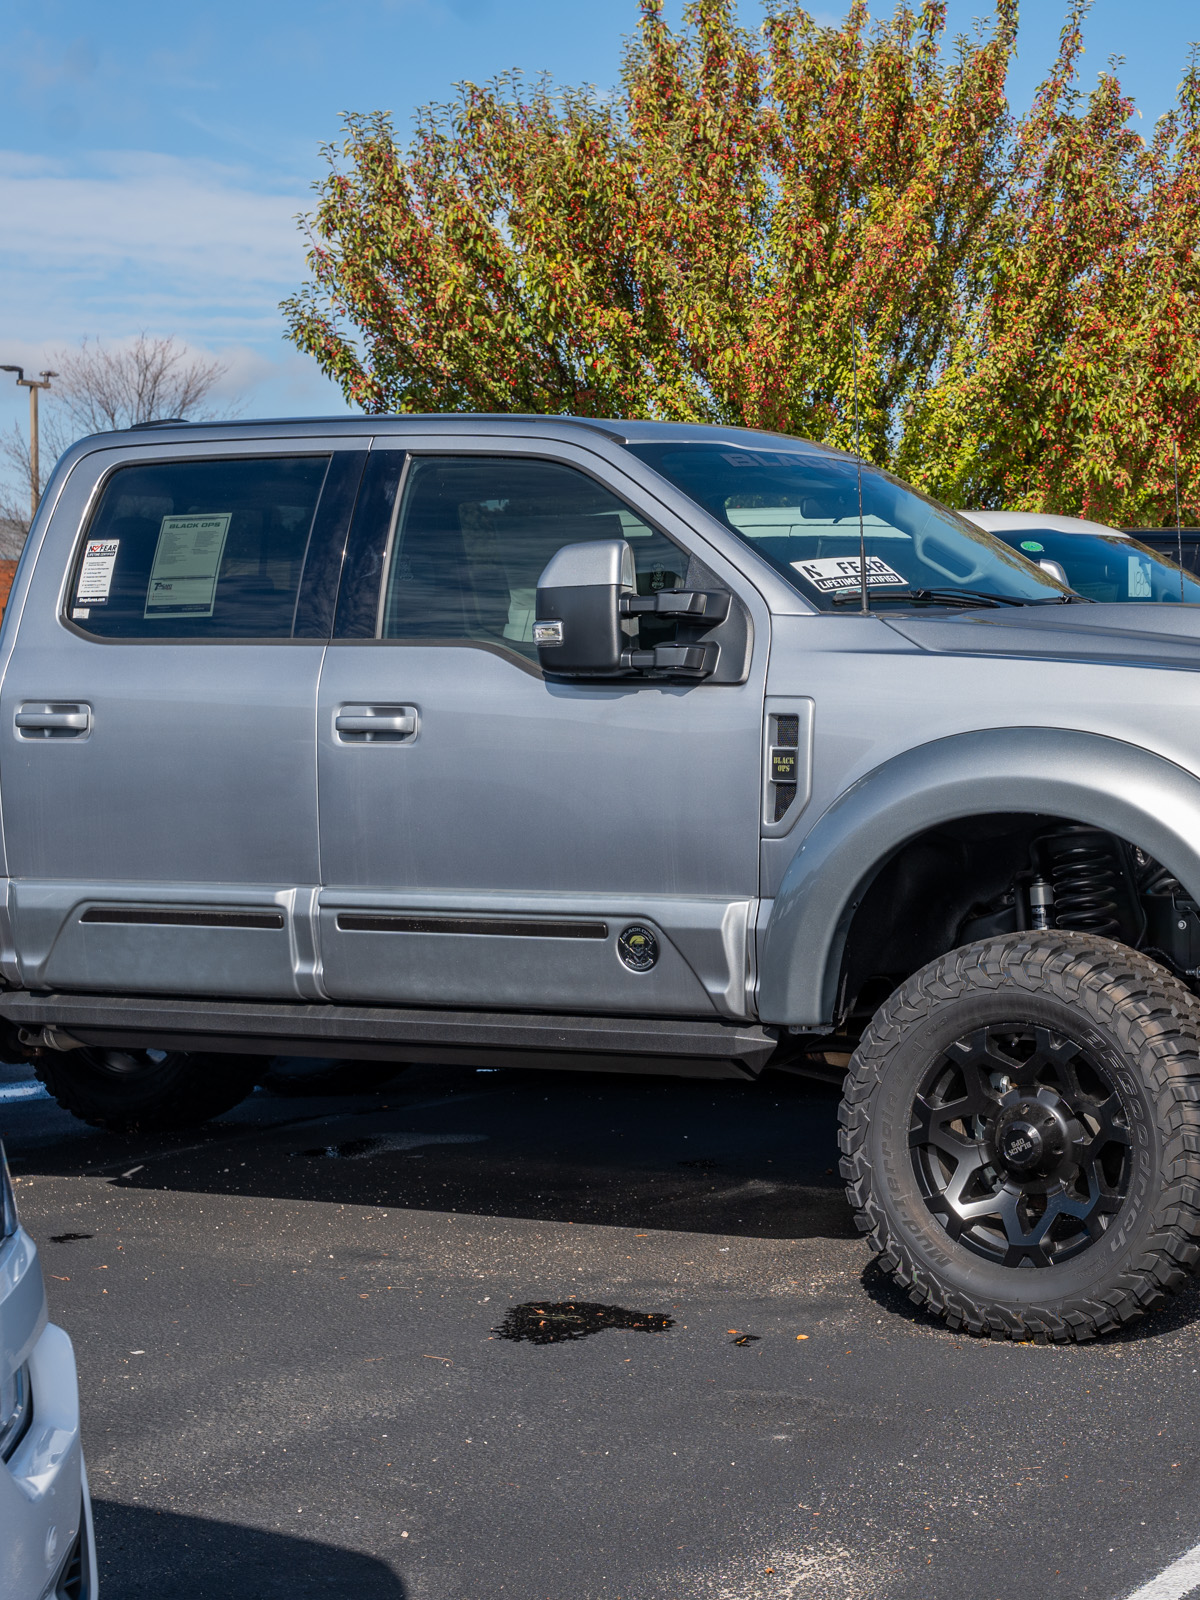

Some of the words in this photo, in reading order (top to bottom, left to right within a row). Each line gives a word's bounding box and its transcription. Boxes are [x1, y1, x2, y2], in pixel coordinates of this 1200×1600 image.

[100, 544, 118, 552] FEAR
[836, 560, 891, 575] FEAR
[818, 577, 859, 589] LIFETIME
[773, 757, 795, 765] BLACK
[777, 764, 791, 772] OPS
[1010, 1137, 1025, 1149] OPS
[1080, 1028, 1150, 1252] BFGoodrich
[1008, 1141, 1032, 1156] BLACK
